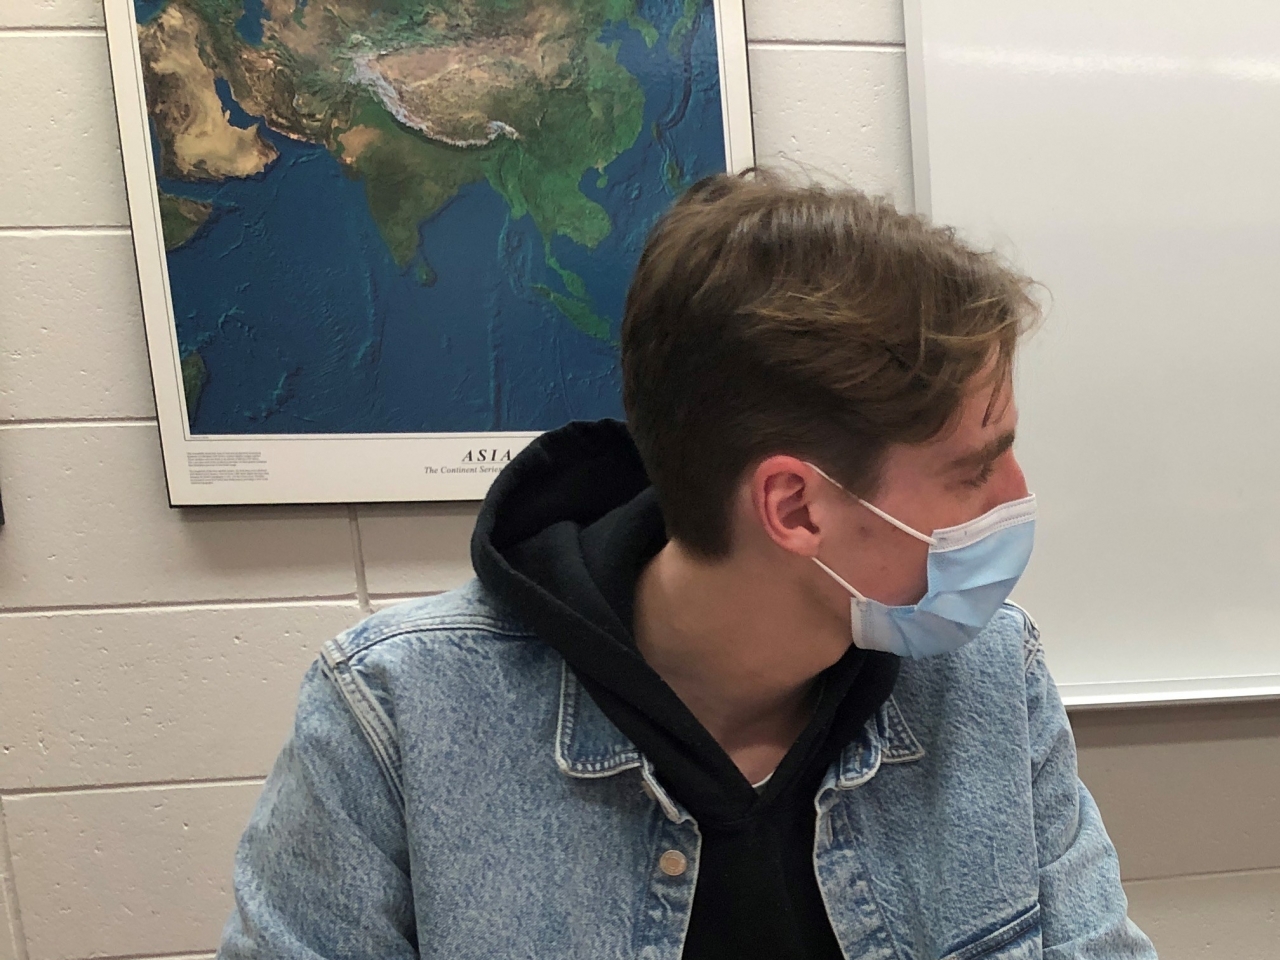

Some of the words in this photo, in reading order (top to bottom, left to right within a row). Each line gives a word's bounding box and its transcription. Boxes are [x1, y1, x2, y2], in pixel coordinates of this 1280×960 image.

[461, 449, 512, 461] ASIA
[424, 466, 438, 474] The
[440, 466, 477, 474] Continent
